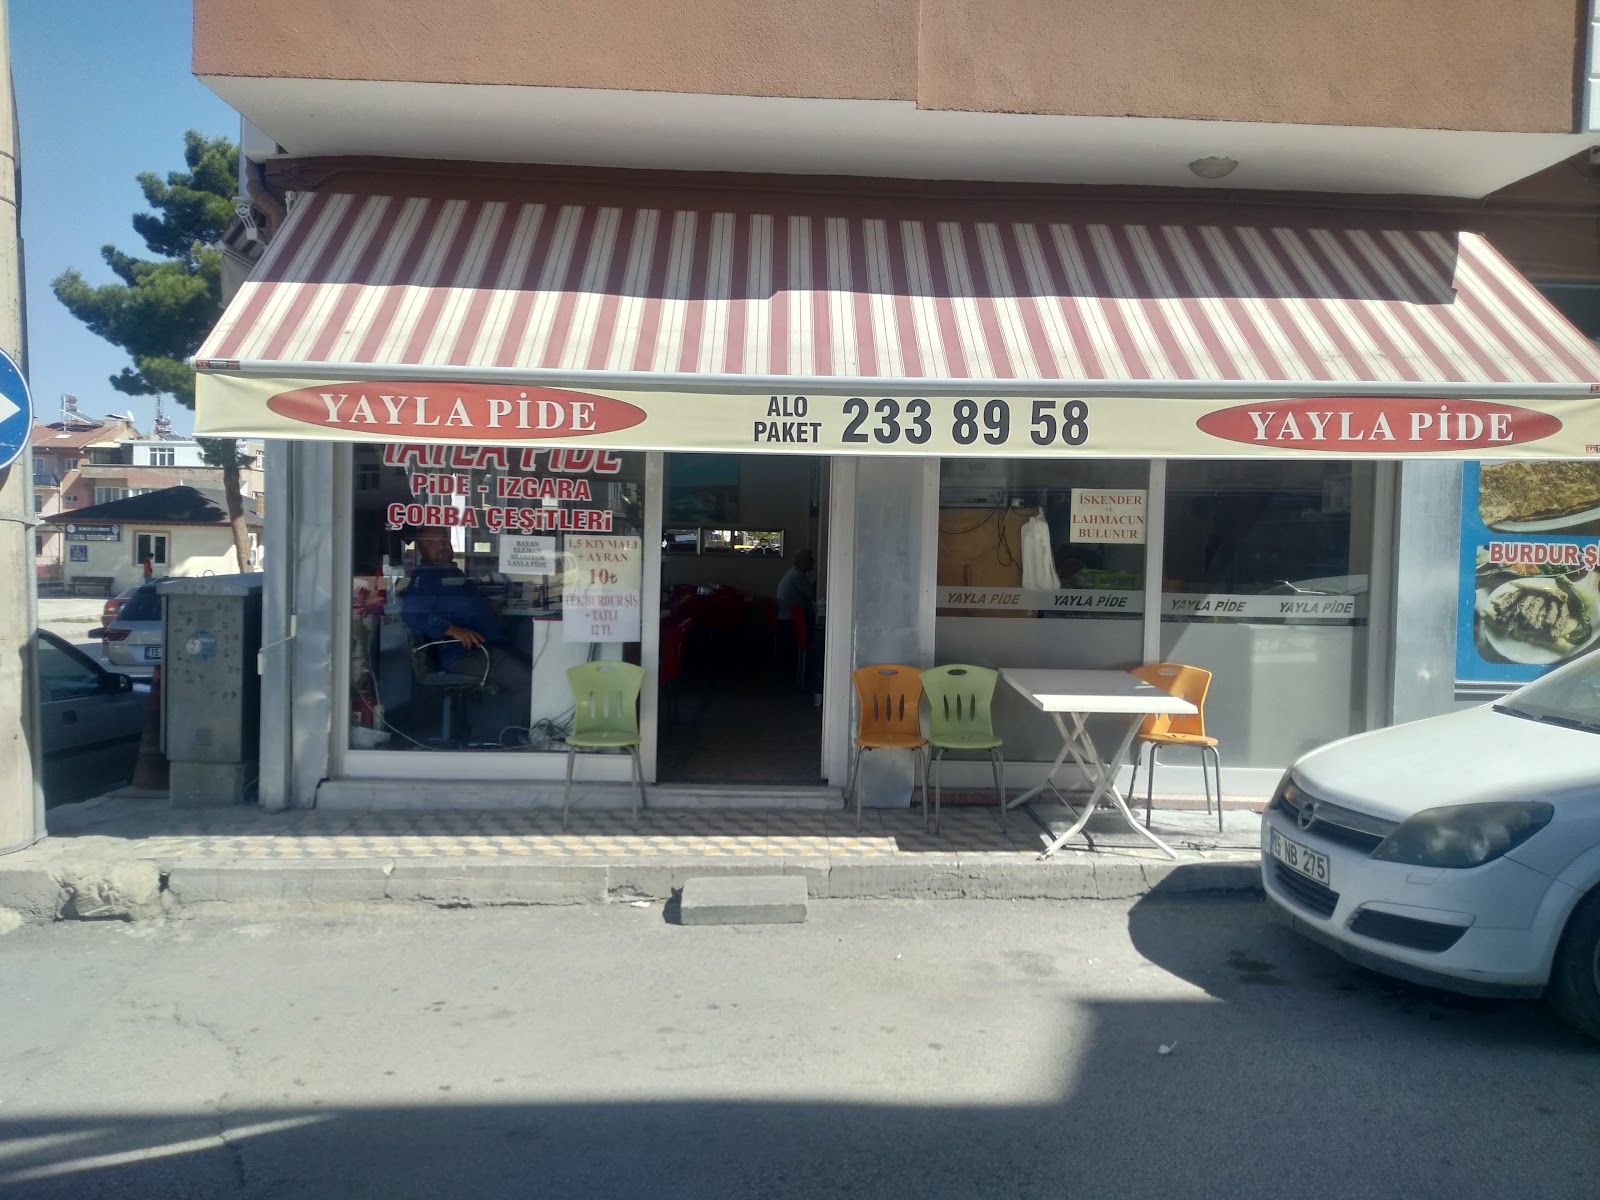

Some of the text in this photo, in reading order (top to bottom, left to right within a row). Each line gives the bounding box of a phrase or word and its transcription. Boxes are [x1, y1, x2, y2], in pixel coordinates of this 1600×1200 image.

[319, 392, 597, 431] YAYLA PİDE
[767, 396, 808, 417] ALO
[841, 397, 1089, 445] 233 89 58
[1248, 404, 1514, 441] YAYLA PİDE
[753, 421, 822, 443] PAKET
[497, 476, 592, 502] IZGARA
[1080, 493, 1142, 505] İSKENDER
[386, 502, 479, 532] ÇORBA
[1072, 514, 1145, 525] LAHMACUN
[1078, 528, 1138, 539] BULUNUR
[587, 552, 629, 562] AYRAN
[1489, 541, 1580, 566] BURDUR
[584, 595, 624, 607] BURDUR
[947, 592, 987, 605] YAYLA
[1053, 595, 1093, 607] YAYLA
[1170, 599, 1211, 611] YAYLA
[1279, 602, 1319, 614] YAYLA
[592, 609, 618, 621] TATLI
[591, 624, 614, 636] 12 TL
[151, 648, 159, 657] 15
[1285, 840, 1297, 867] NB
[1303, 849, 1326, 879] 275
